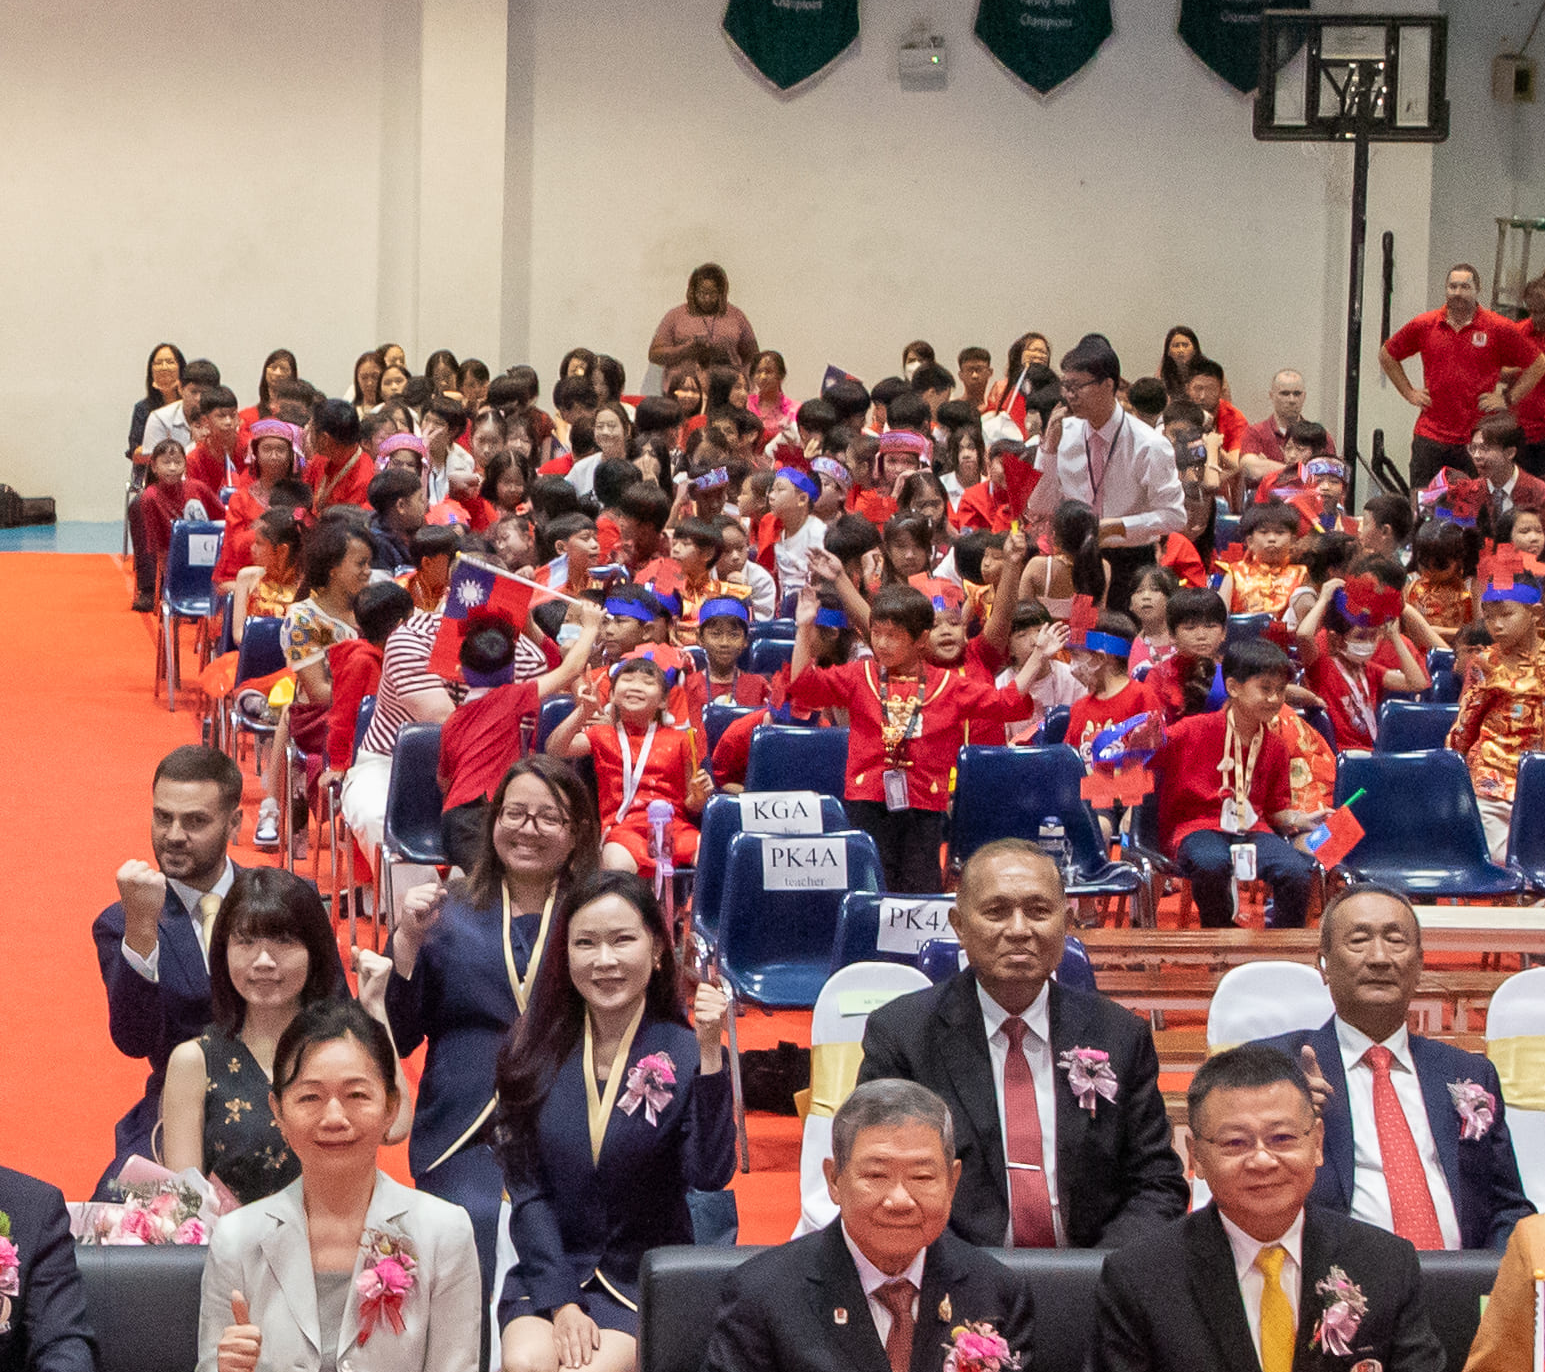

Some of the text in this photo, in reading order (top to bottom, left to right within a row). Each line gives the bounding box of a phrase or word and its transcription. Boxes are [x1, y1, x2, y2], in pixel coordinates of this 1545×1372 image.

[753, 800, 809, 821] KGA
[771, 846, 839, 869] PK4A
[784, 875, 826, 888] teacher
